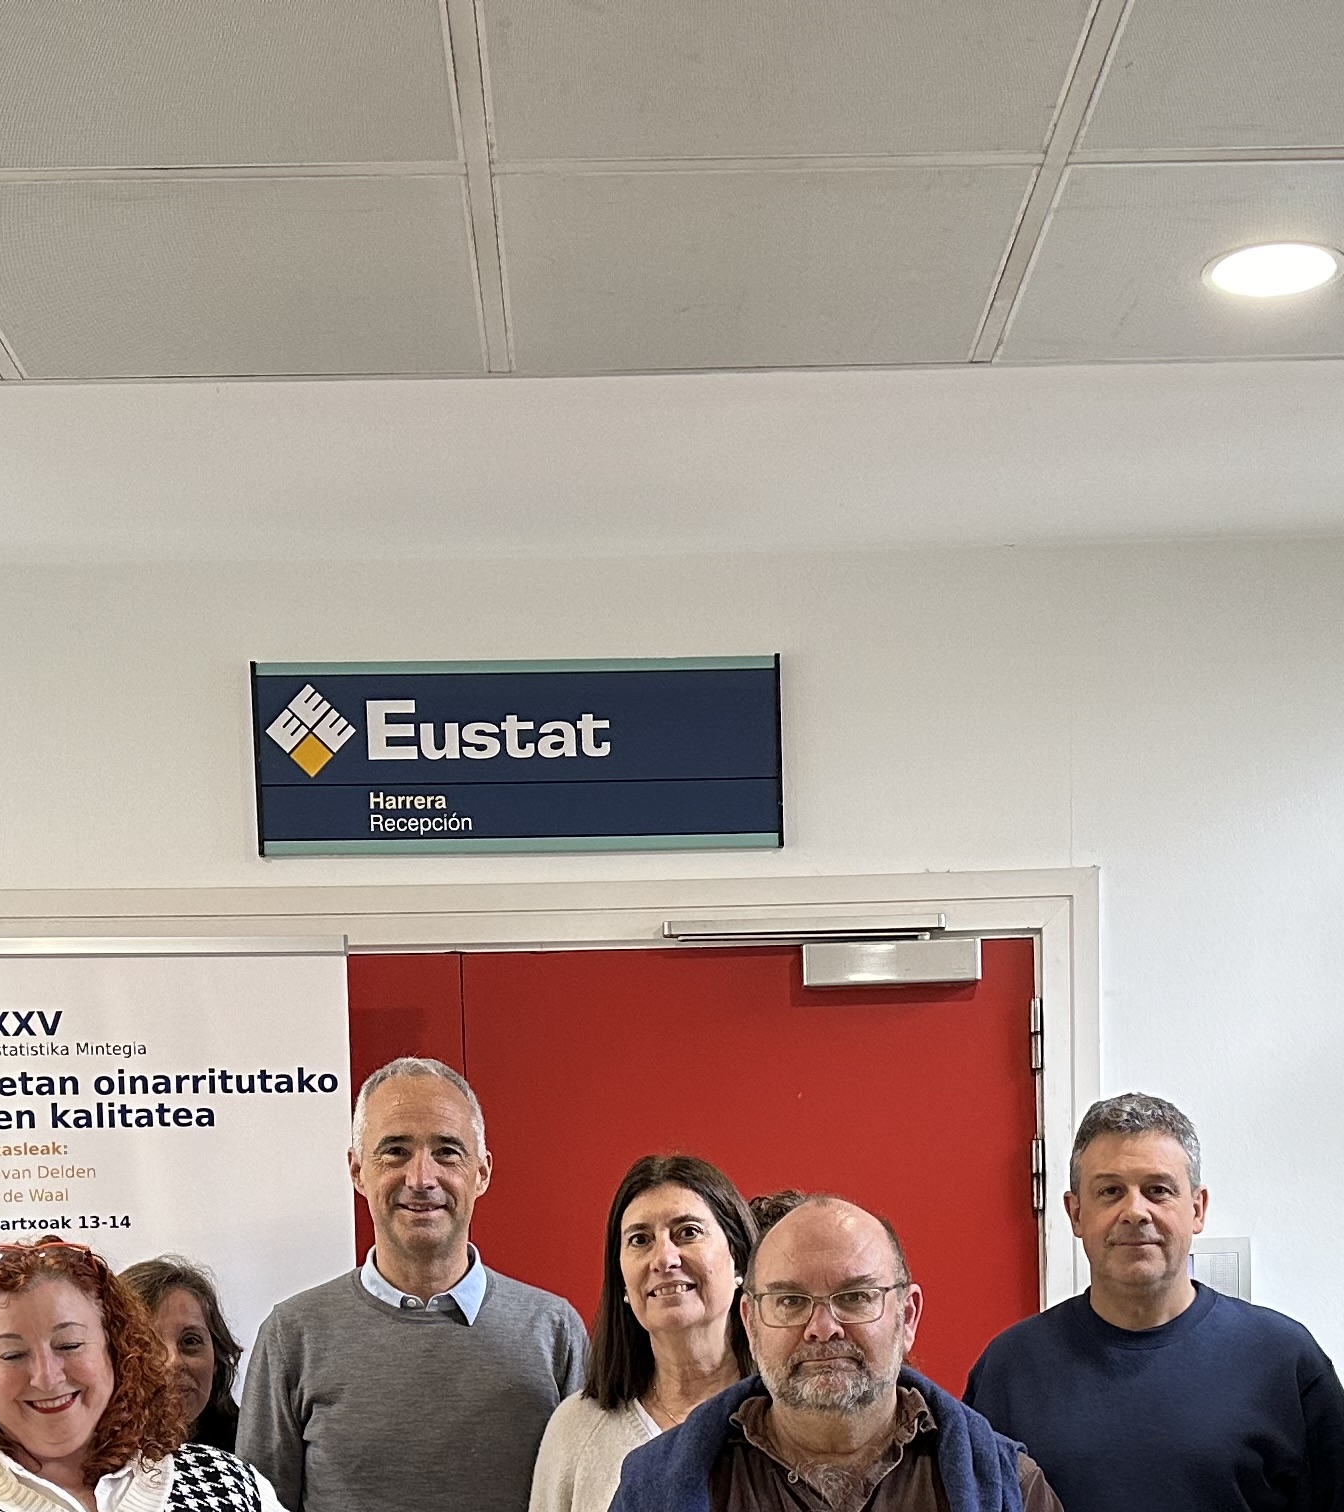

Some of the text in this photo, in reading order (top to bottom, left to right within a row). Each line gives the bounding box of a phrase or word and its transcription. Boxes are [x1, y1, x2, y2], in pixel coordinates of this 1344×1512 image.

[365, 699, 611, 761] Eustat
[369, 791, 447, 810] Harrera
[369, 811, 473, 835] Recepción
[75, 1040, 147, 1058] Mintegia
[93, 1066, 339, 1096] oinarritutako
[50, 1101, 216, 1130] kalitatea
[0, 1168, 33, 1180] van
[36, 1164, 97, 1179] Delden
[2, 1188, 24, 1203] de
[28, 1186, 69, 1203] Waal
[78, 1215, 132, 1230] 13-14
